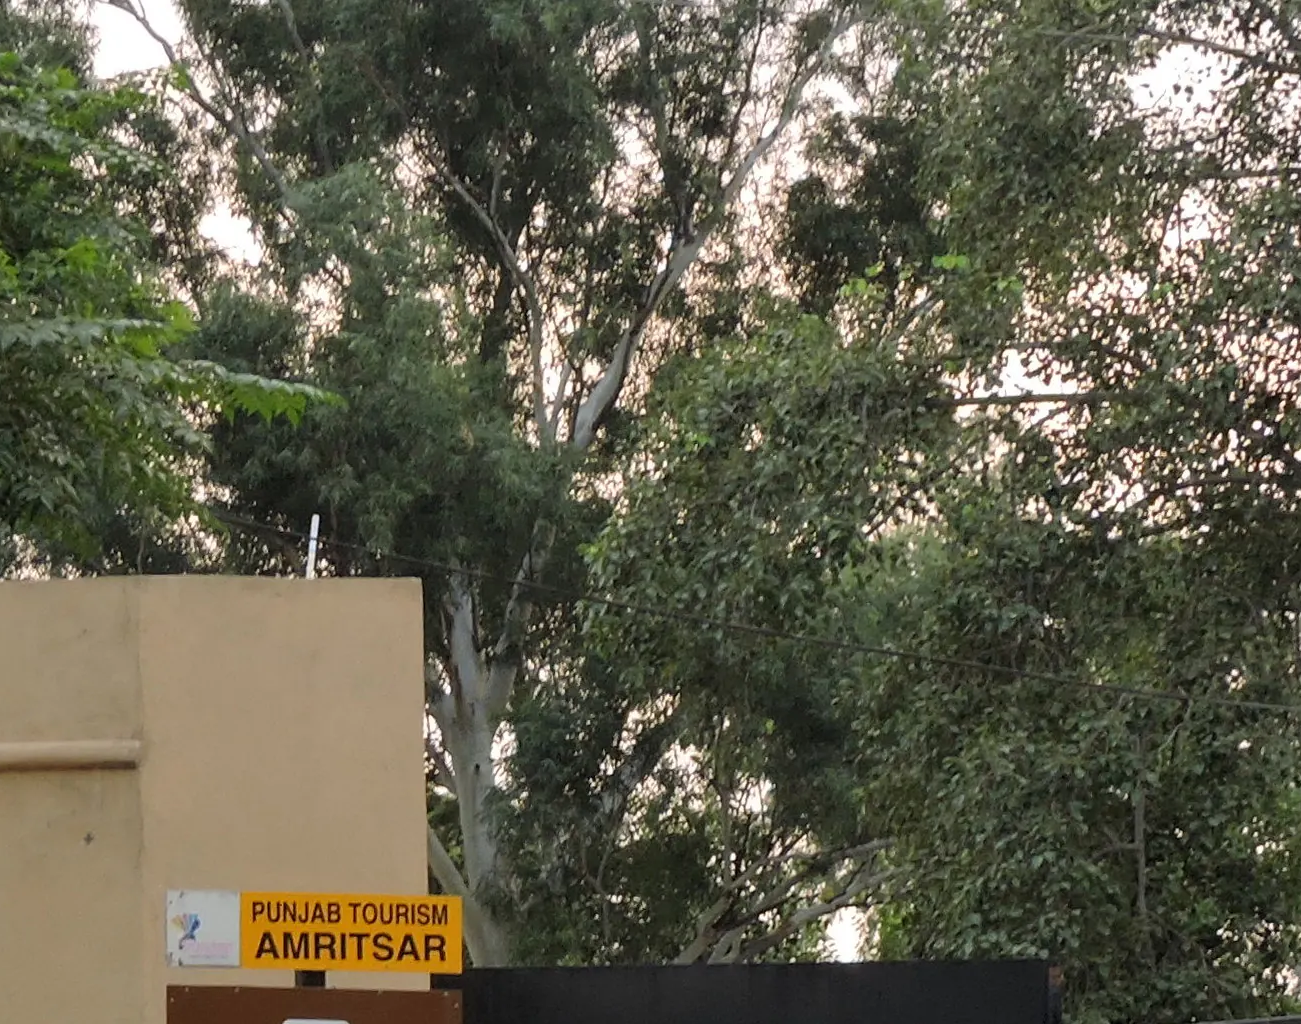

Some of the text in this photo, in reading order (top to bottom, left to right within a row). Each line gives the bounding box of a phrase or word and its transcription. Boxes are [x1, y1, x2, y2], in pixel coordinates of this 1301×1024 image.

[251, 901, 448, 925] PUNJAB TOURISM
[254, 931, 447, 962] AMRITSAR
